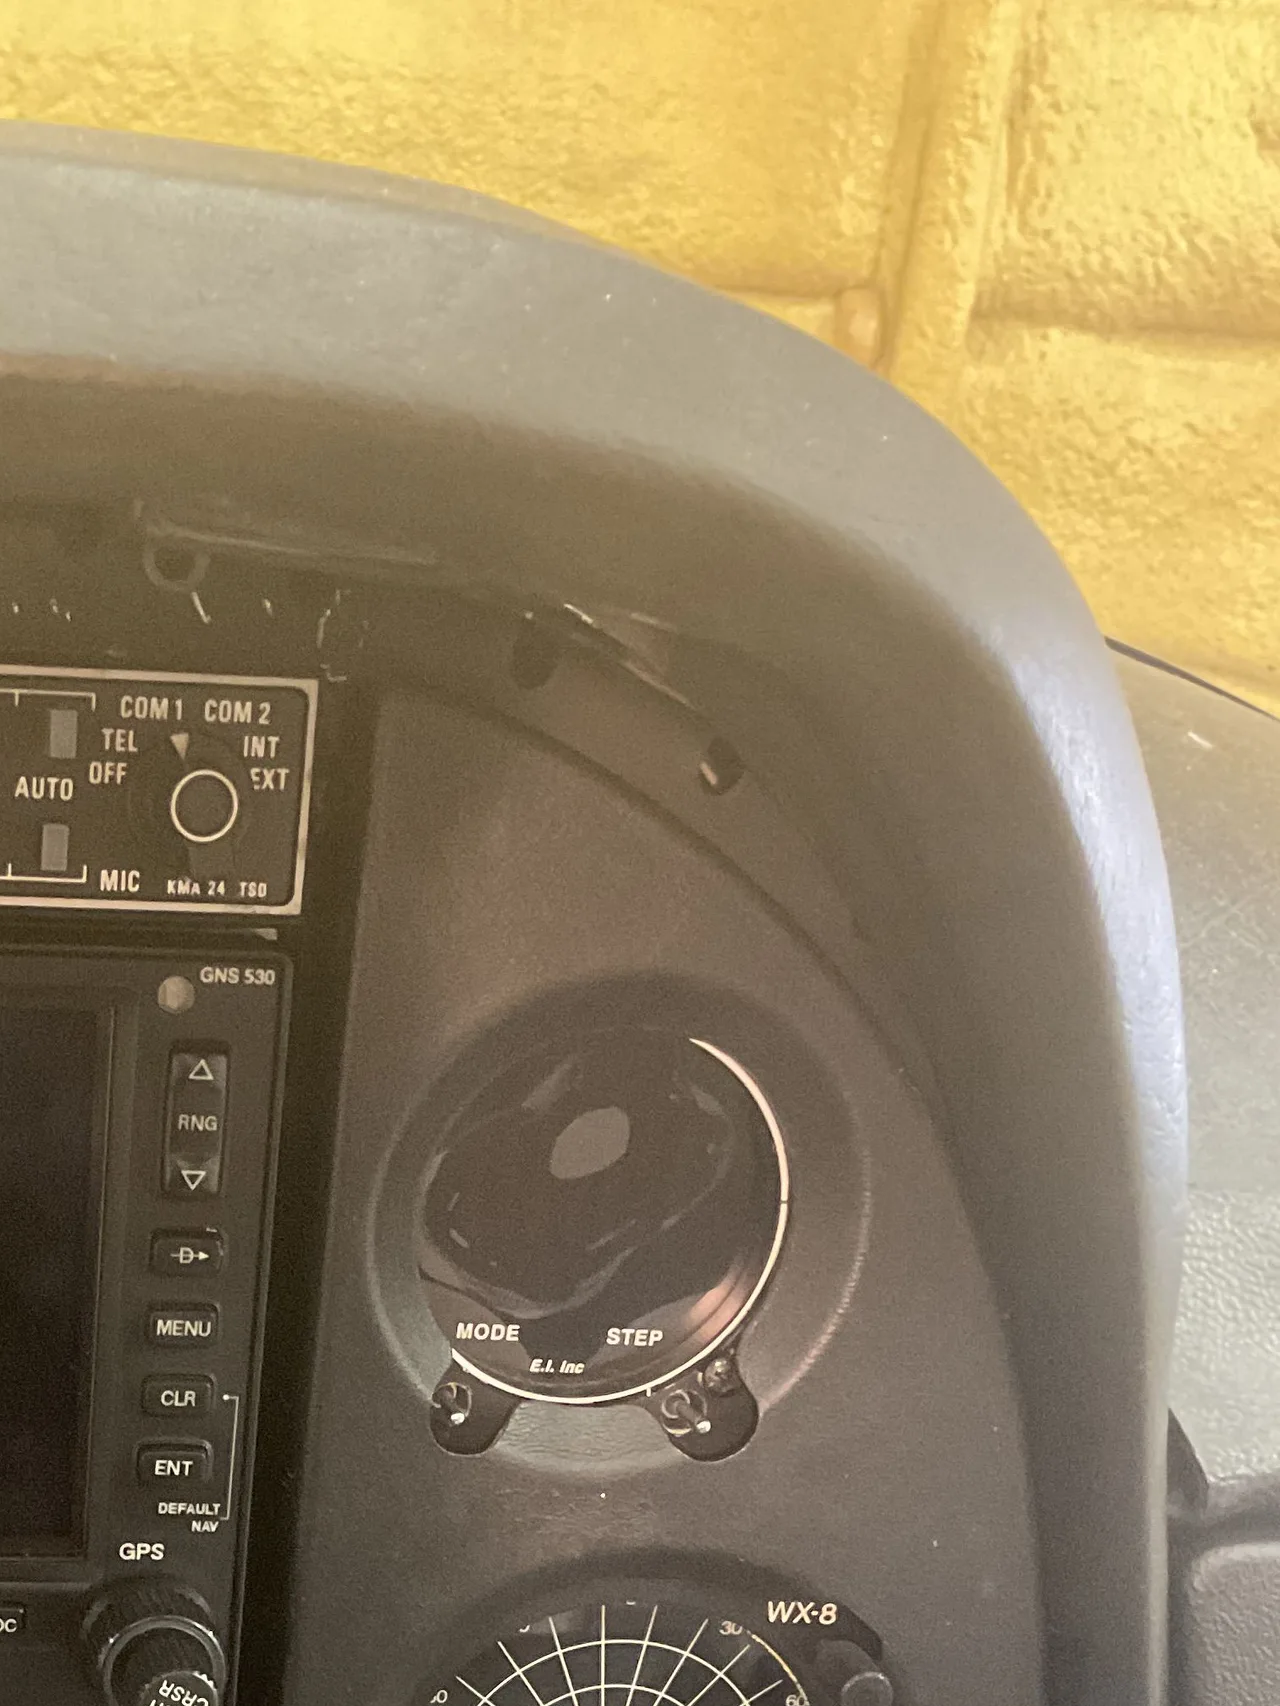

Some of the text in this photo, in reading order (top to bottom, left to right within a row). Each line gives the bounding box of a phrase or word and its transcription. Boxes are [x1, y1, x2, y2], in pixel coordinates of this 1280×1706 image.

[102, 728, 138, 752] TEL
[243, 736, 279, 758] INT
[89, 762, 127, 785] OFF
[250, 768, 289, 791] EXT
[15, 777, 74, 800] AUTO
[100, 870, 140, 892] MIC
[208, 880, 225, 896] 24
[200, 966, 276, 985] GNS 530
[178, 1115, 218, 1132] RNG
[156, 1320, 212, 1337] MENU
[456, 1323, 520, 1342] MODE
[607, 1328, 663, 1347] STEP
[161, 1391, 196, 1407] CLR
[154, 1460, 193, 1477] ENT
[158, 1503, 220, 1516] DEFAULT
[191, 1520, 219, 1533] NAV
[119, 1542, 165, 1561] GPS
[767, 1601, 838, 1625] WX-8
